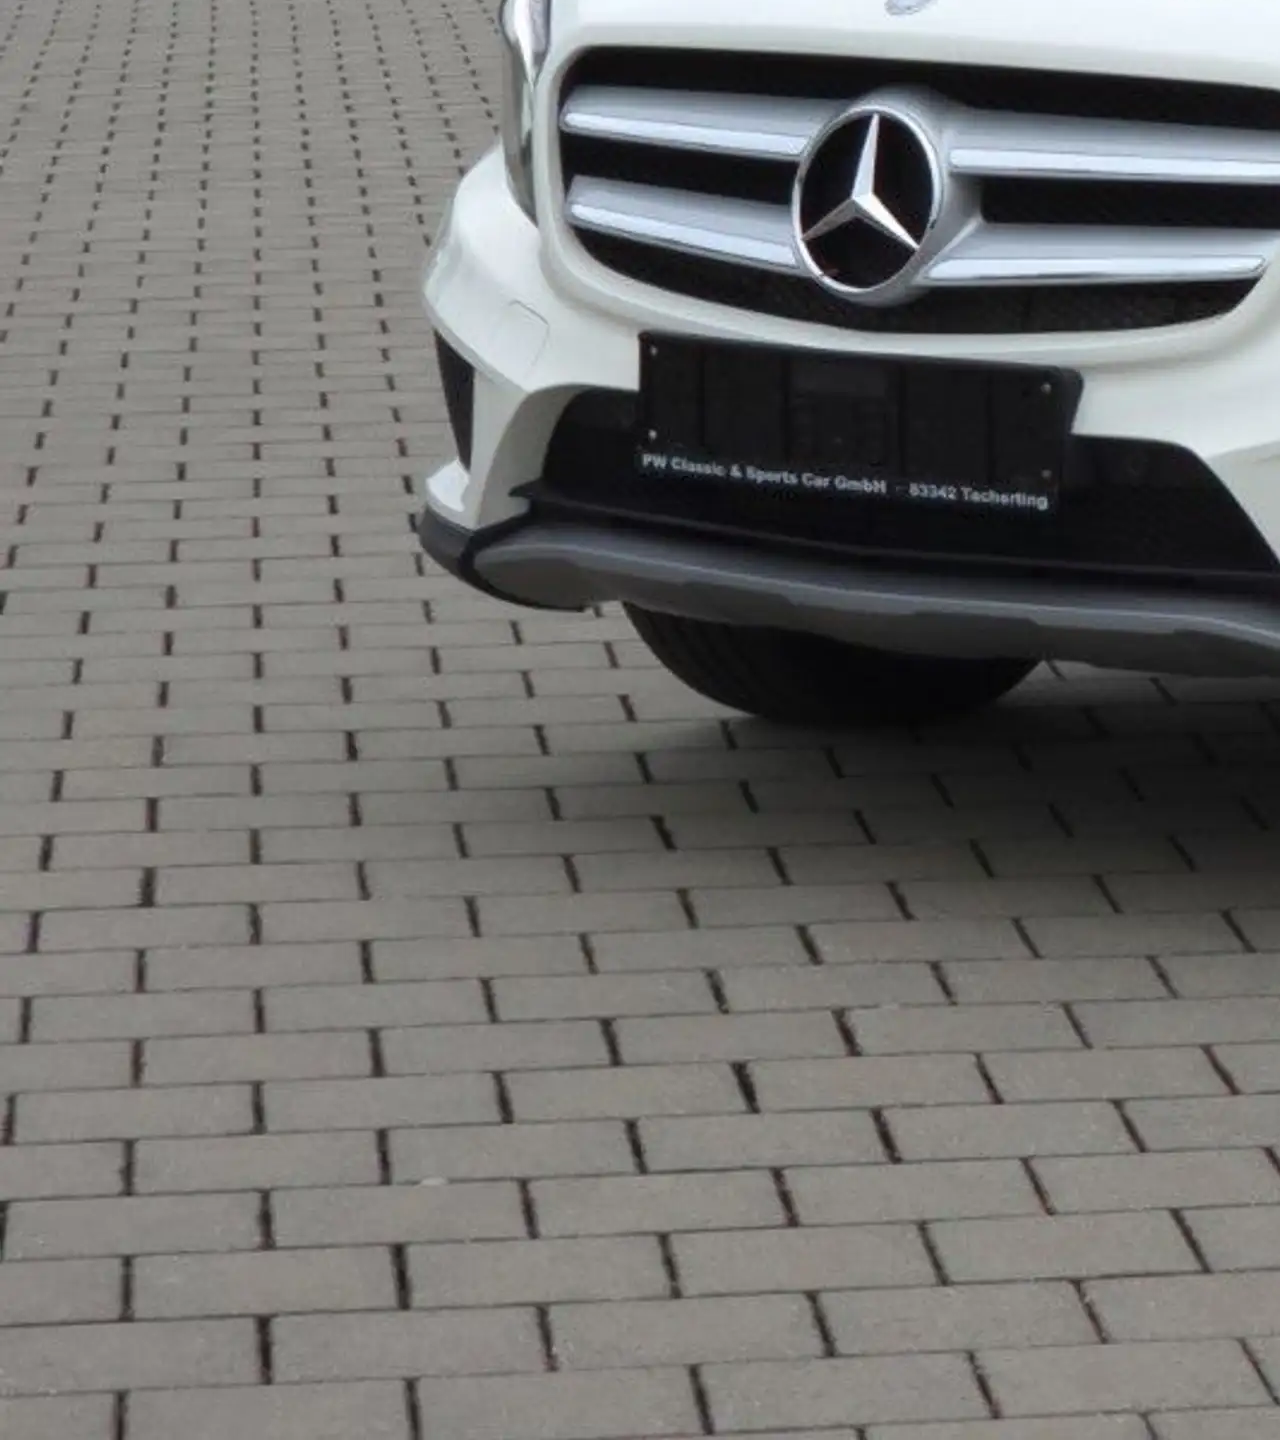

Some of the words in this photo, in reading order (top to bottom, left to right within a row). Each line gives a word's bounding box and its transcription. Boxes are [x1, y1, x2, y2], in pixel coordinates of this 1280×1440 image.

[642, 453, 666, 469] PW
[746, 465, 798, 485] Sports
[801, 472, 830, 489] Car
[835, 474, 887, 493] GmbH
